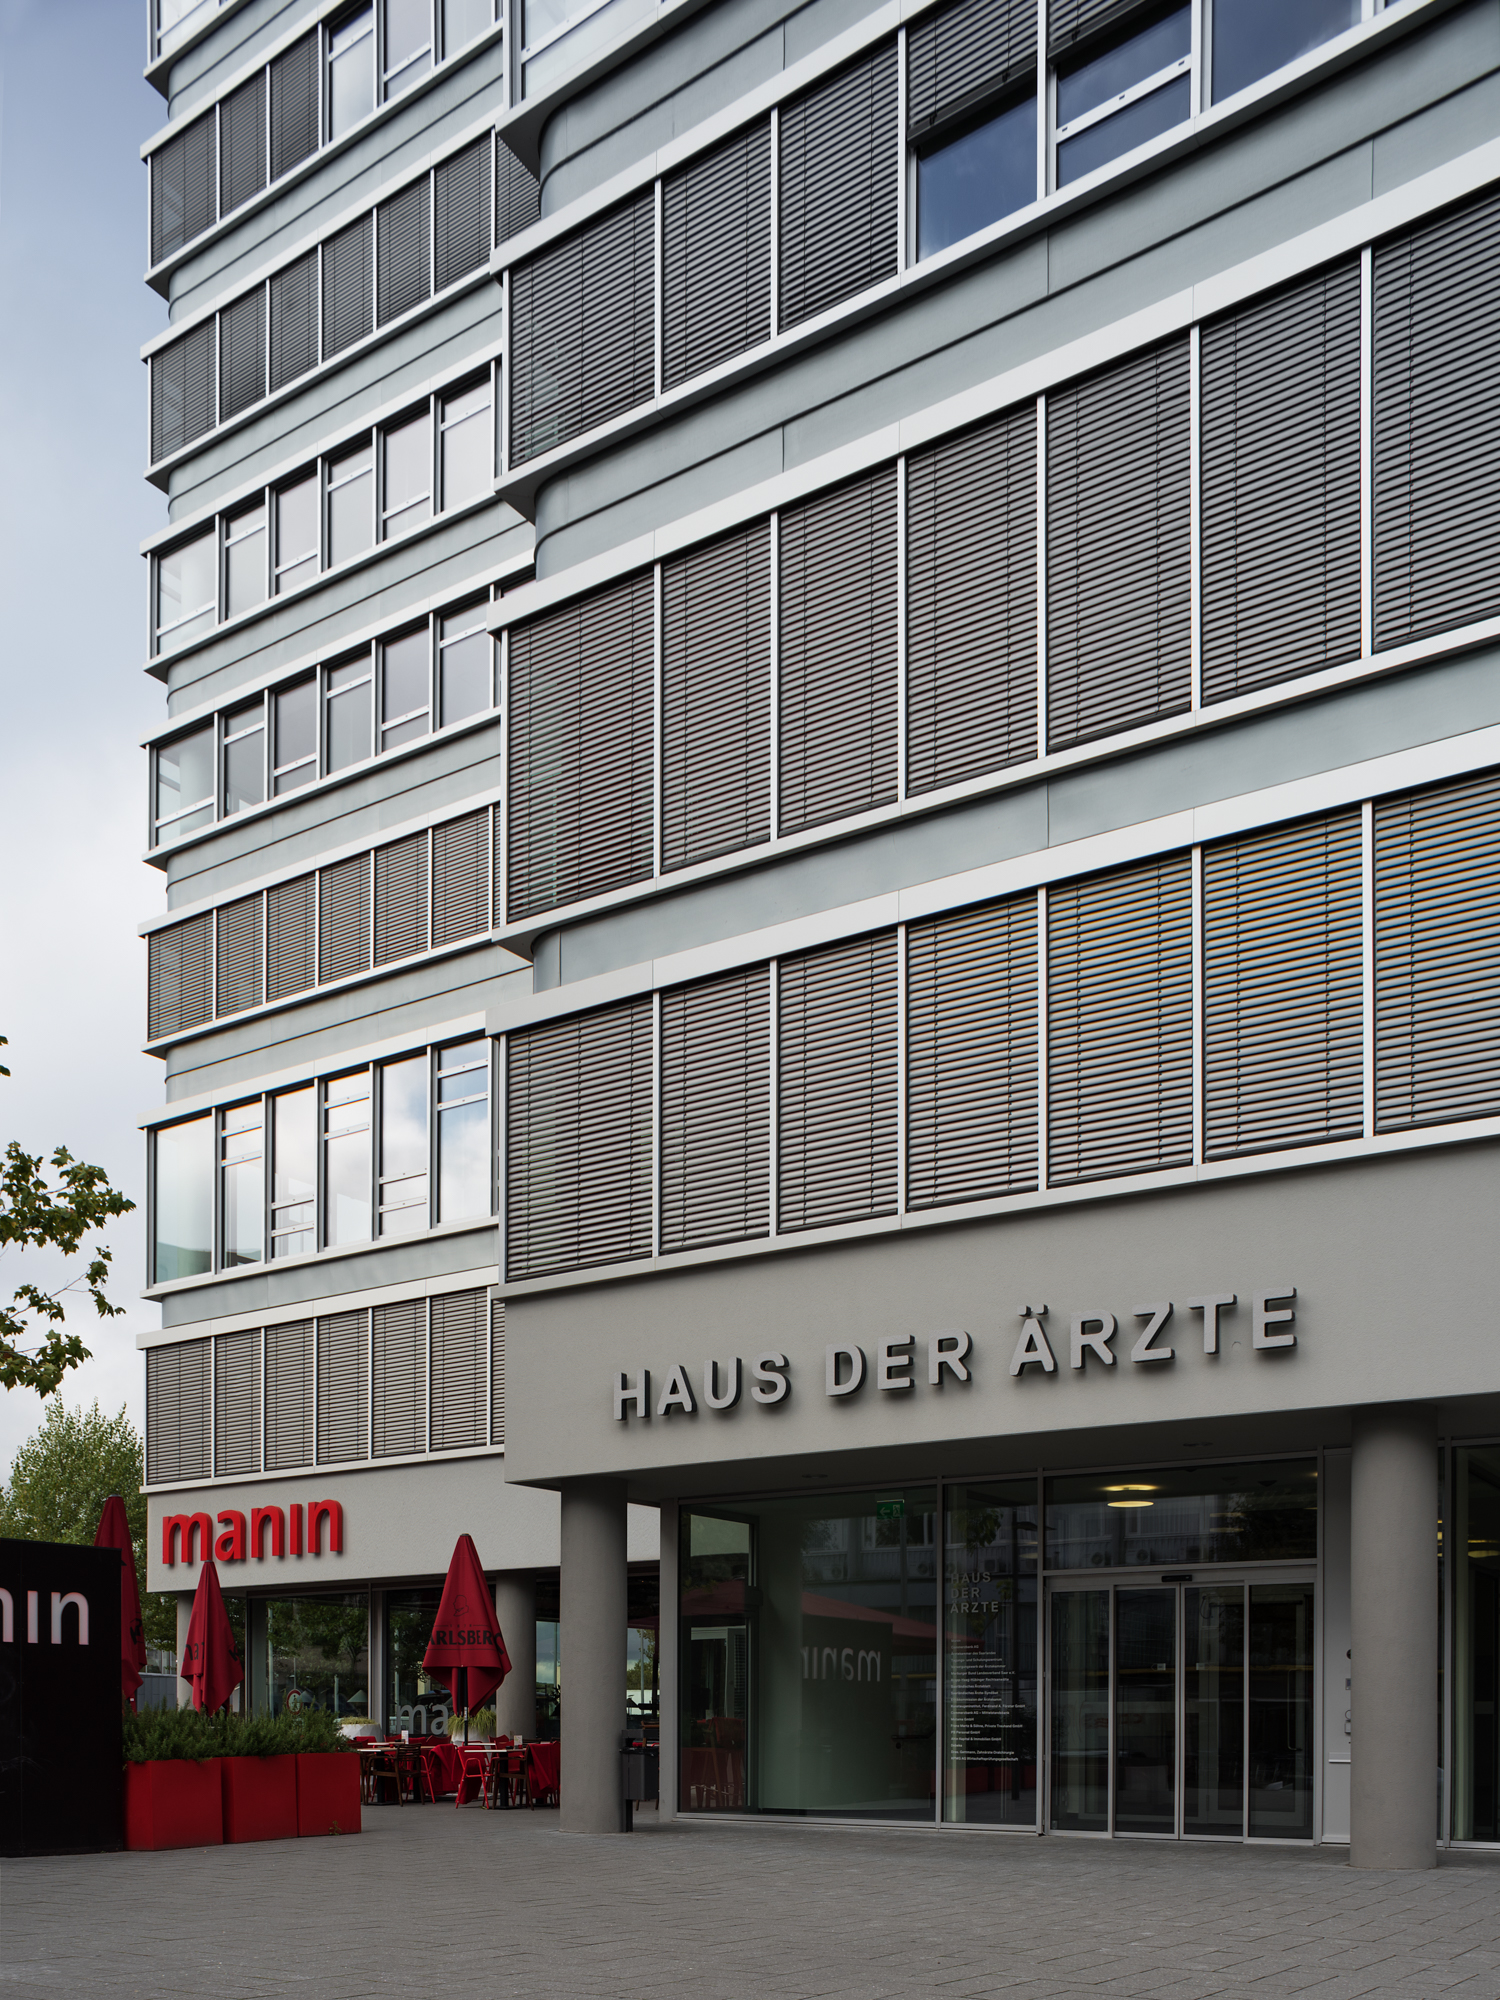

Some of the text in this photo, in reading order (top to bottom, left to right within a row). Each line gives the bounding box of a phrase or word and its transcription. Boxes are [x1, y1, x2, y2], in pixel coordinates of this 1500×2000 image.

[613, 1287, 1297, 1421] HAUS DER ÄRZTE
[162, 1499, 343, 1564] manin
[951, 1571, 991, 1584] HAUS
[951, 1587, 980, 1598] DER
[950, 1600, 999, 1614] ÄRZTE
